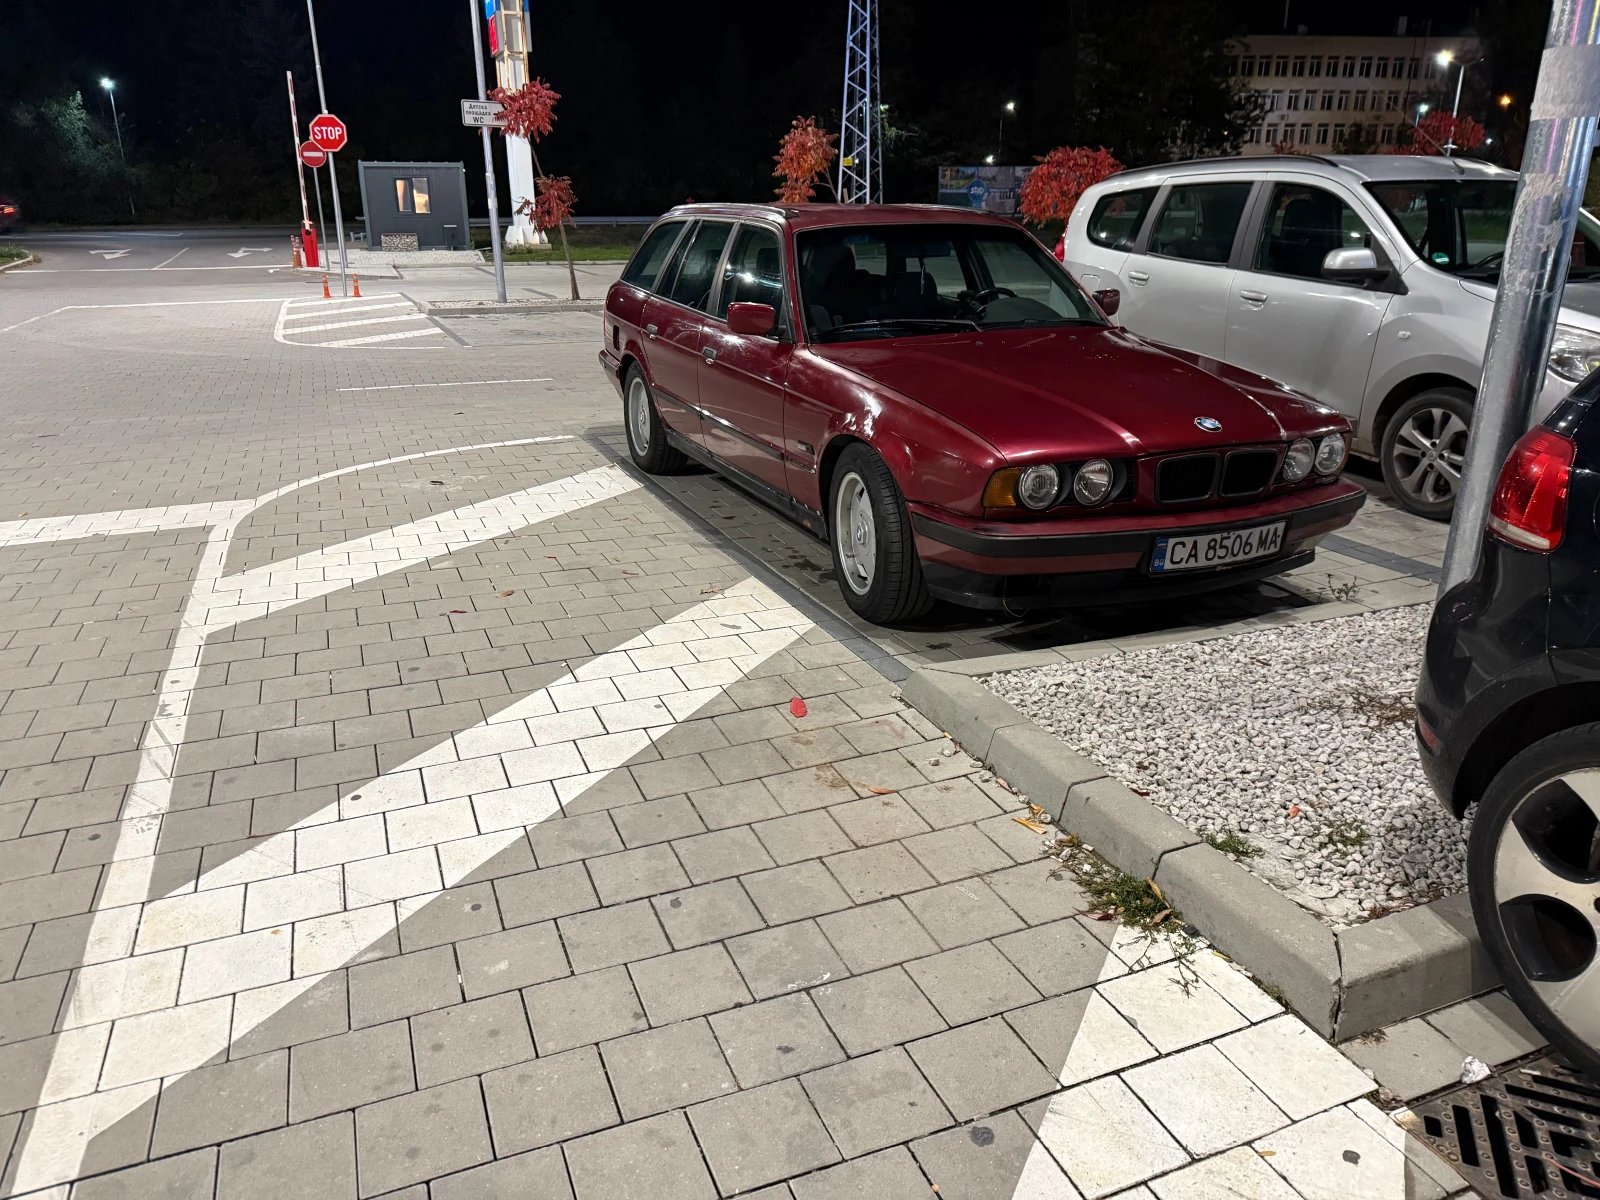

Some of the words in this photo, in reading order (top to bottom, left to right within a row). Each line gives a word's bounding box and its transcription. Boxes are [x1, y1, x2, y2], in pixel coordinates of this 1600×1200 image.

[472, 116, 485, 124] WC
[314, 126, 343, 140] STOP
[1169, 540, 1199, 565] CA
[1204, 531, 1254, 561] 8506
[1255, 526, 1279, 554] MA
[1154, 558, 1165, 567] BG
